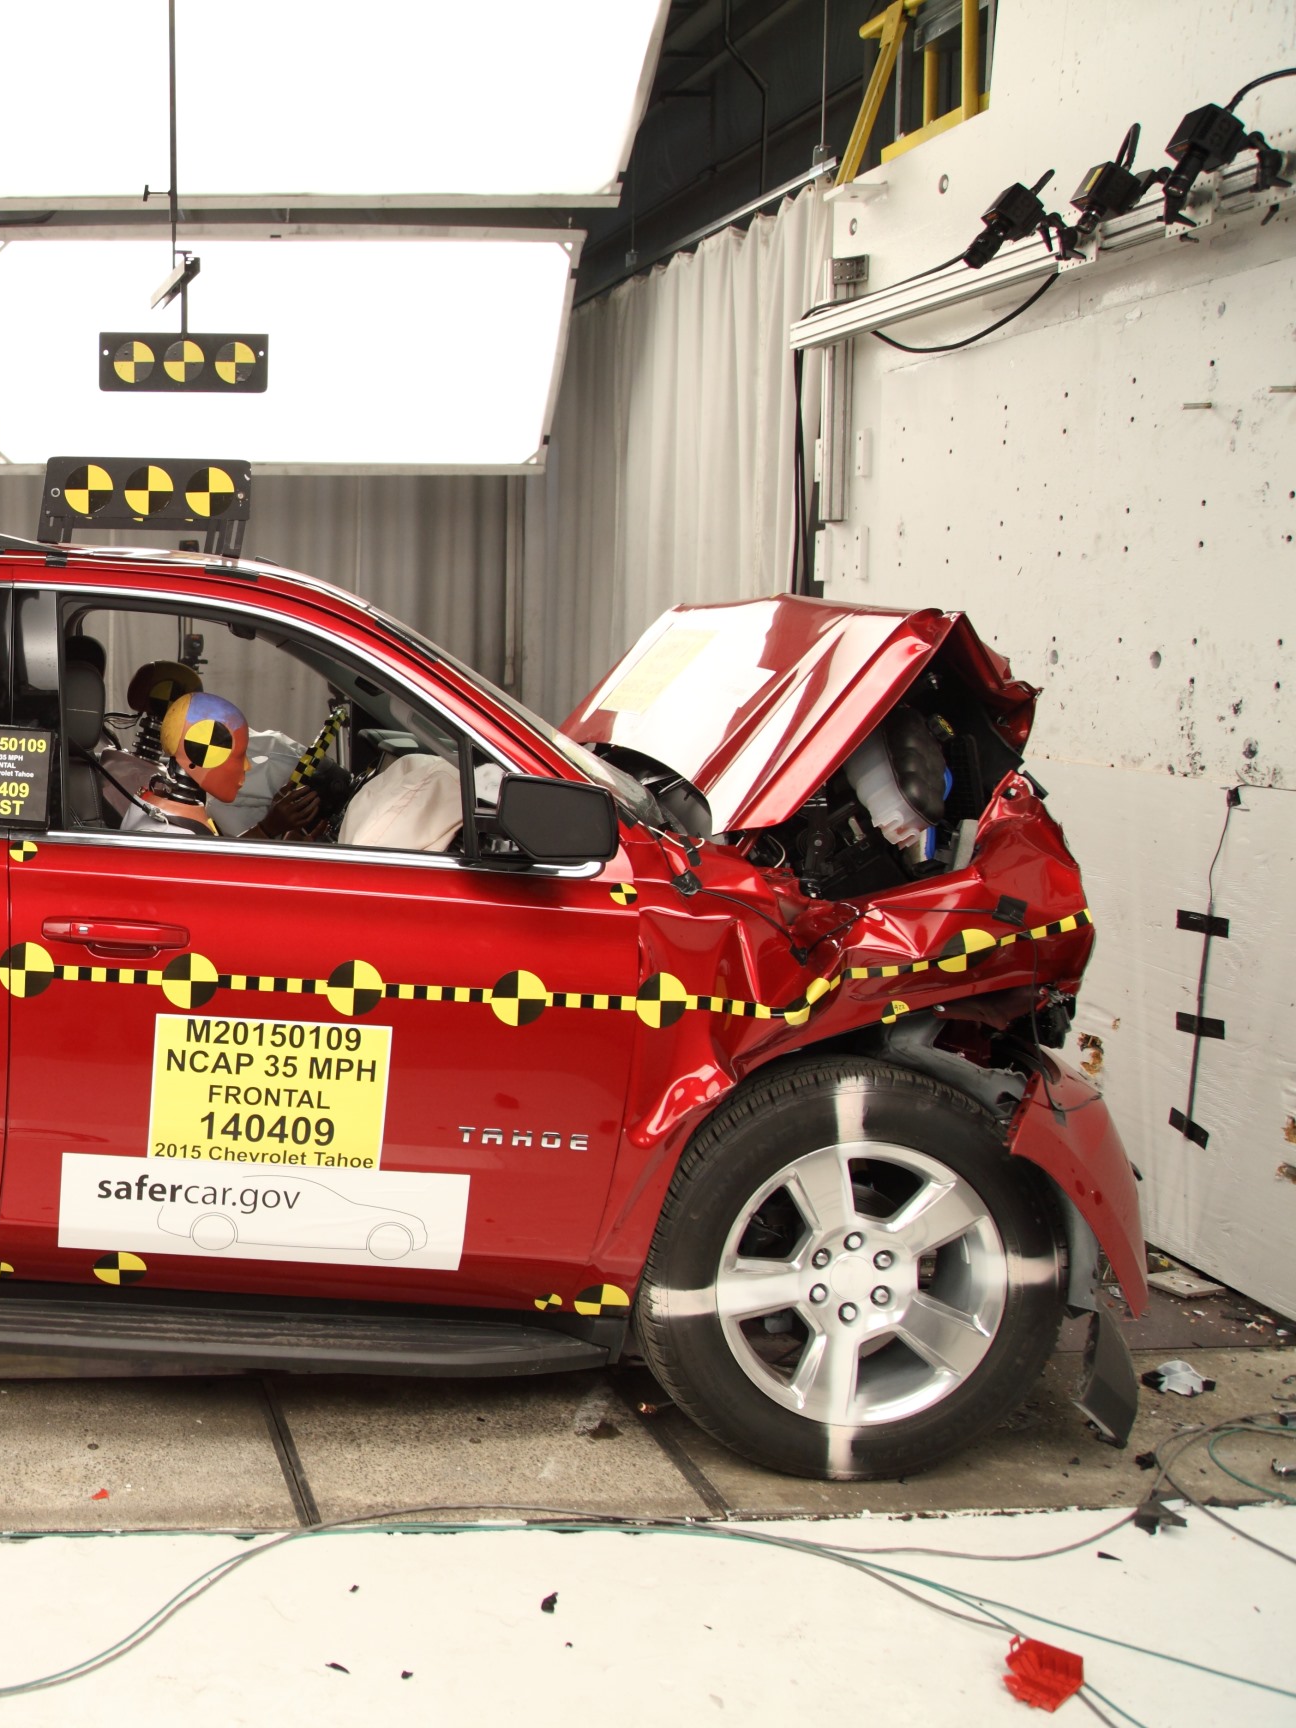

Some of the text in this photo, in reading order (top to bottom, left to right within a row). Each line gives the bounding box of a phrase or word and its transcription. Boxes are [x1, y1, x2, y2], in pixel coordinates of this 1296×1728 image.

[15, 770, 34, 778] Tahoe
[186, 1019, 362, 1052] M20150109
[166, 1049, 377, 1083] NCAP 35 MPH
[208, 1085, 331, 1110] FRONTAL
[199, 1112, 335, 1147] 140409
[458, 1126, 589, 1151] TAHOE
[154, 1142, 374, 1169] 2015 Chevrolet Tahoe
[97, 1174, 301, 1215] safercar.gov
